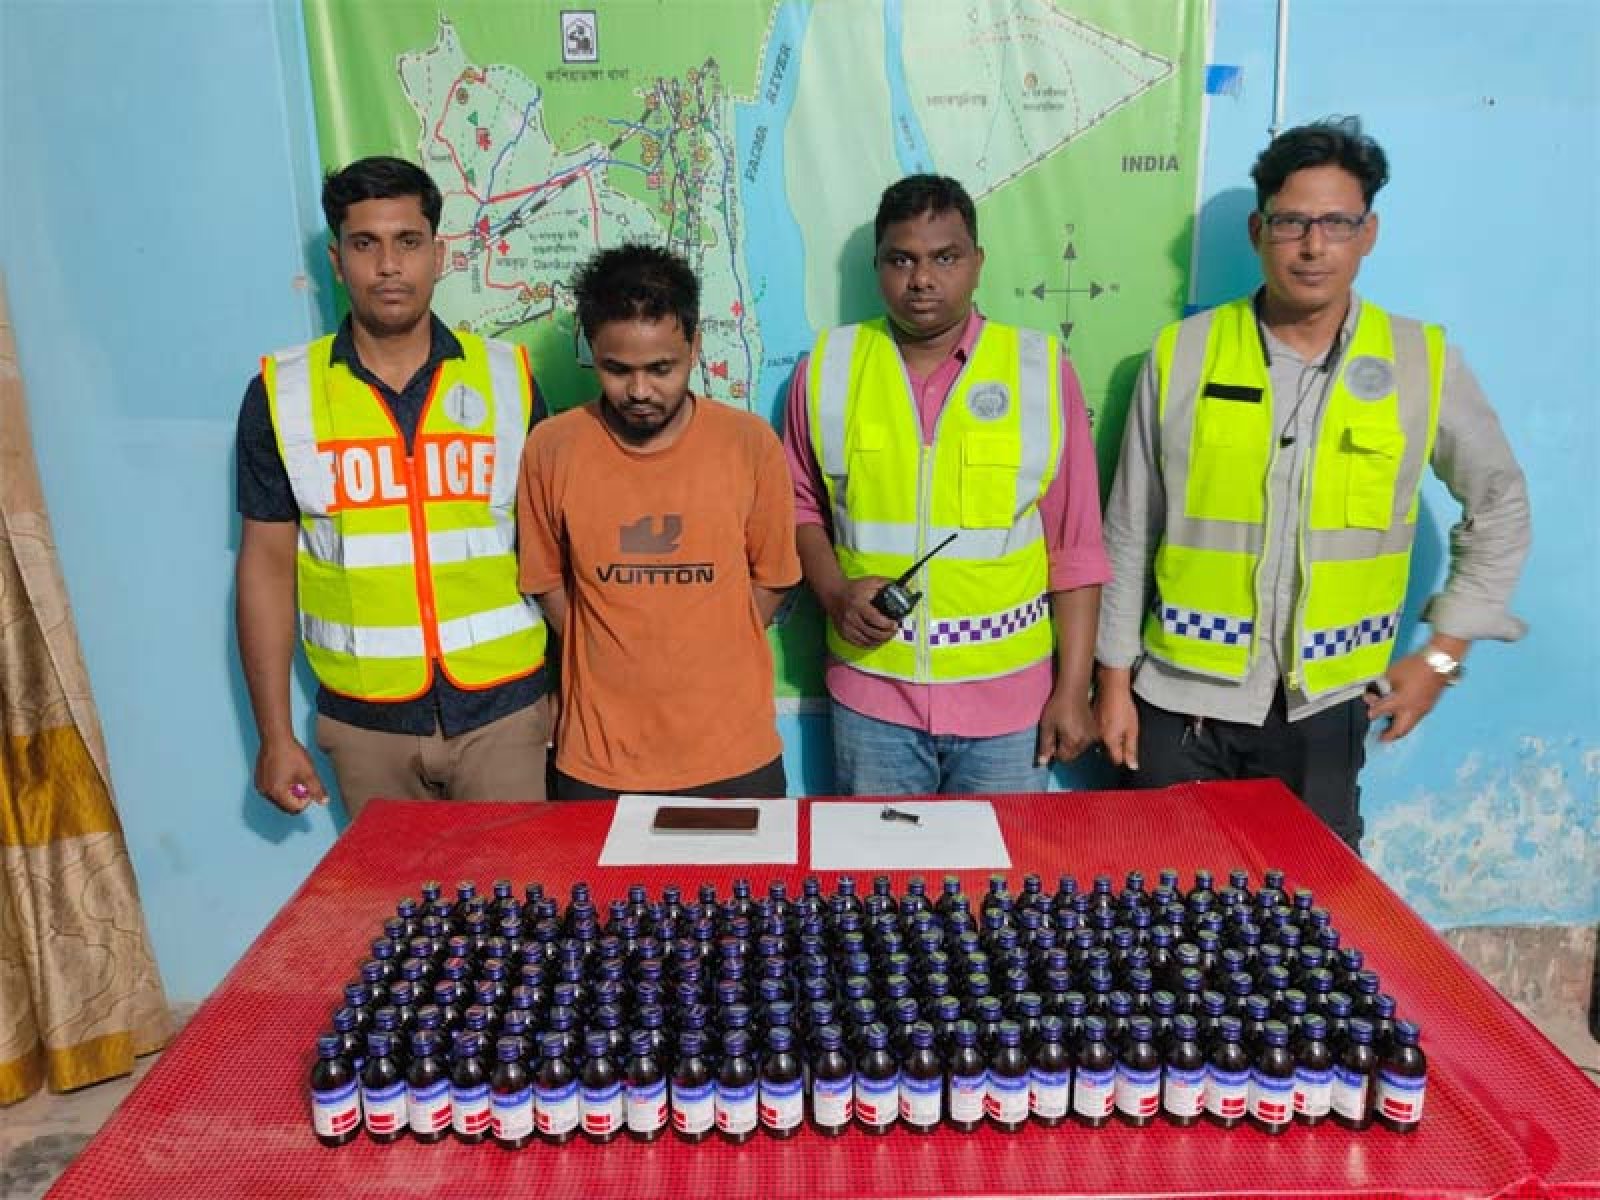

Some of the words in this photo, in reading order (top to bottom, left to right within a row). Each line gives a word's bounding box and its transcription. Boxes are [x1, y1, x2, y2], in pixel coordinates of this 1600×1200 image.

[744, 125, 768, 184] PADMA
[766, 42, 791, 105] RIVER
[1121, 154, 1179, 173] INDIA
[596, 562, 714, 585] VUITTON
